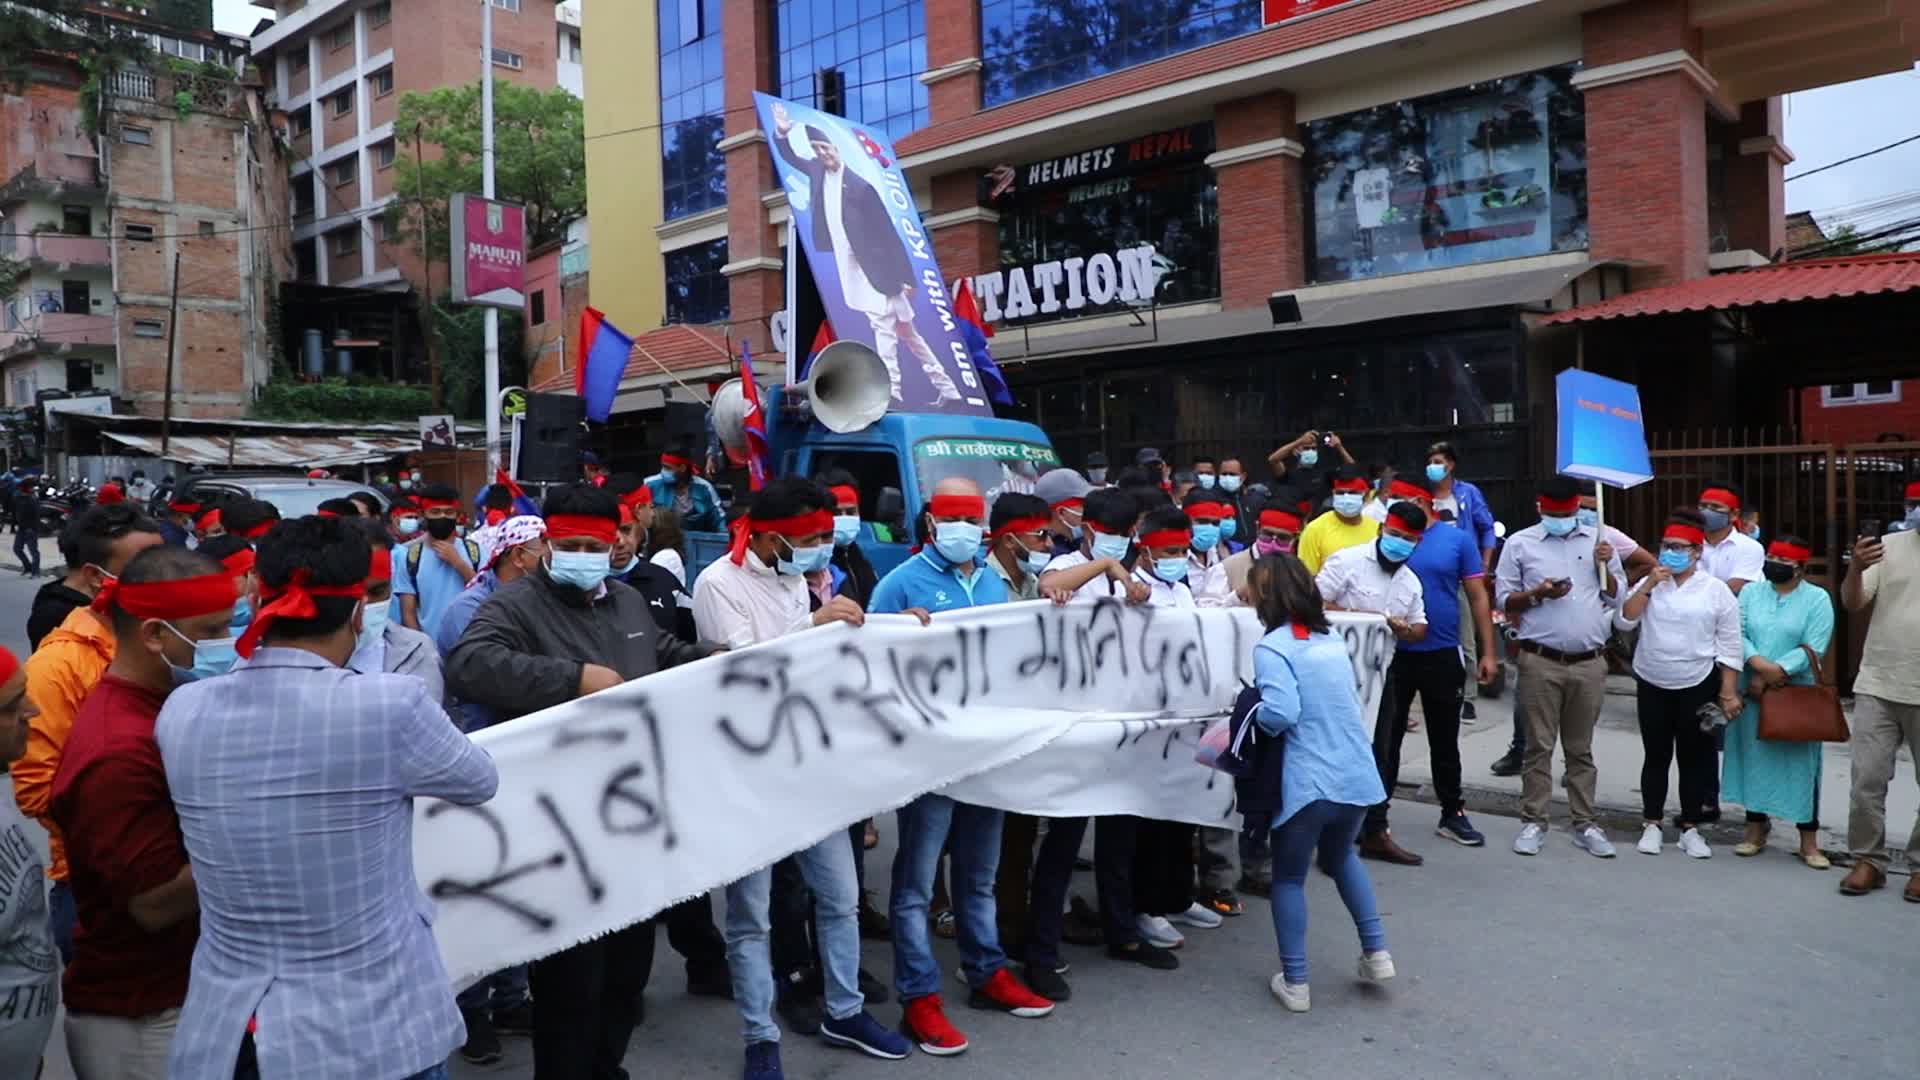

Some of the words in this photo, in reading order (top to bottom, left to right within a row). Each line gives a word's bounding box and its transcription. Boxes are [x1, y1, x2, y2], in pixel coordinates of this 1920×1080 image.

[1028, 147, 1115, 185] HELMETS
[1129, 129, 1193, 161] NEPAL
[882, 171, 909, 211] Oli
[469, 241, 521, 267] MARUTI
[901, 217, 929, 259] KP
[923, 269, 956, 331] with
[951, 341, 977, 388] am
